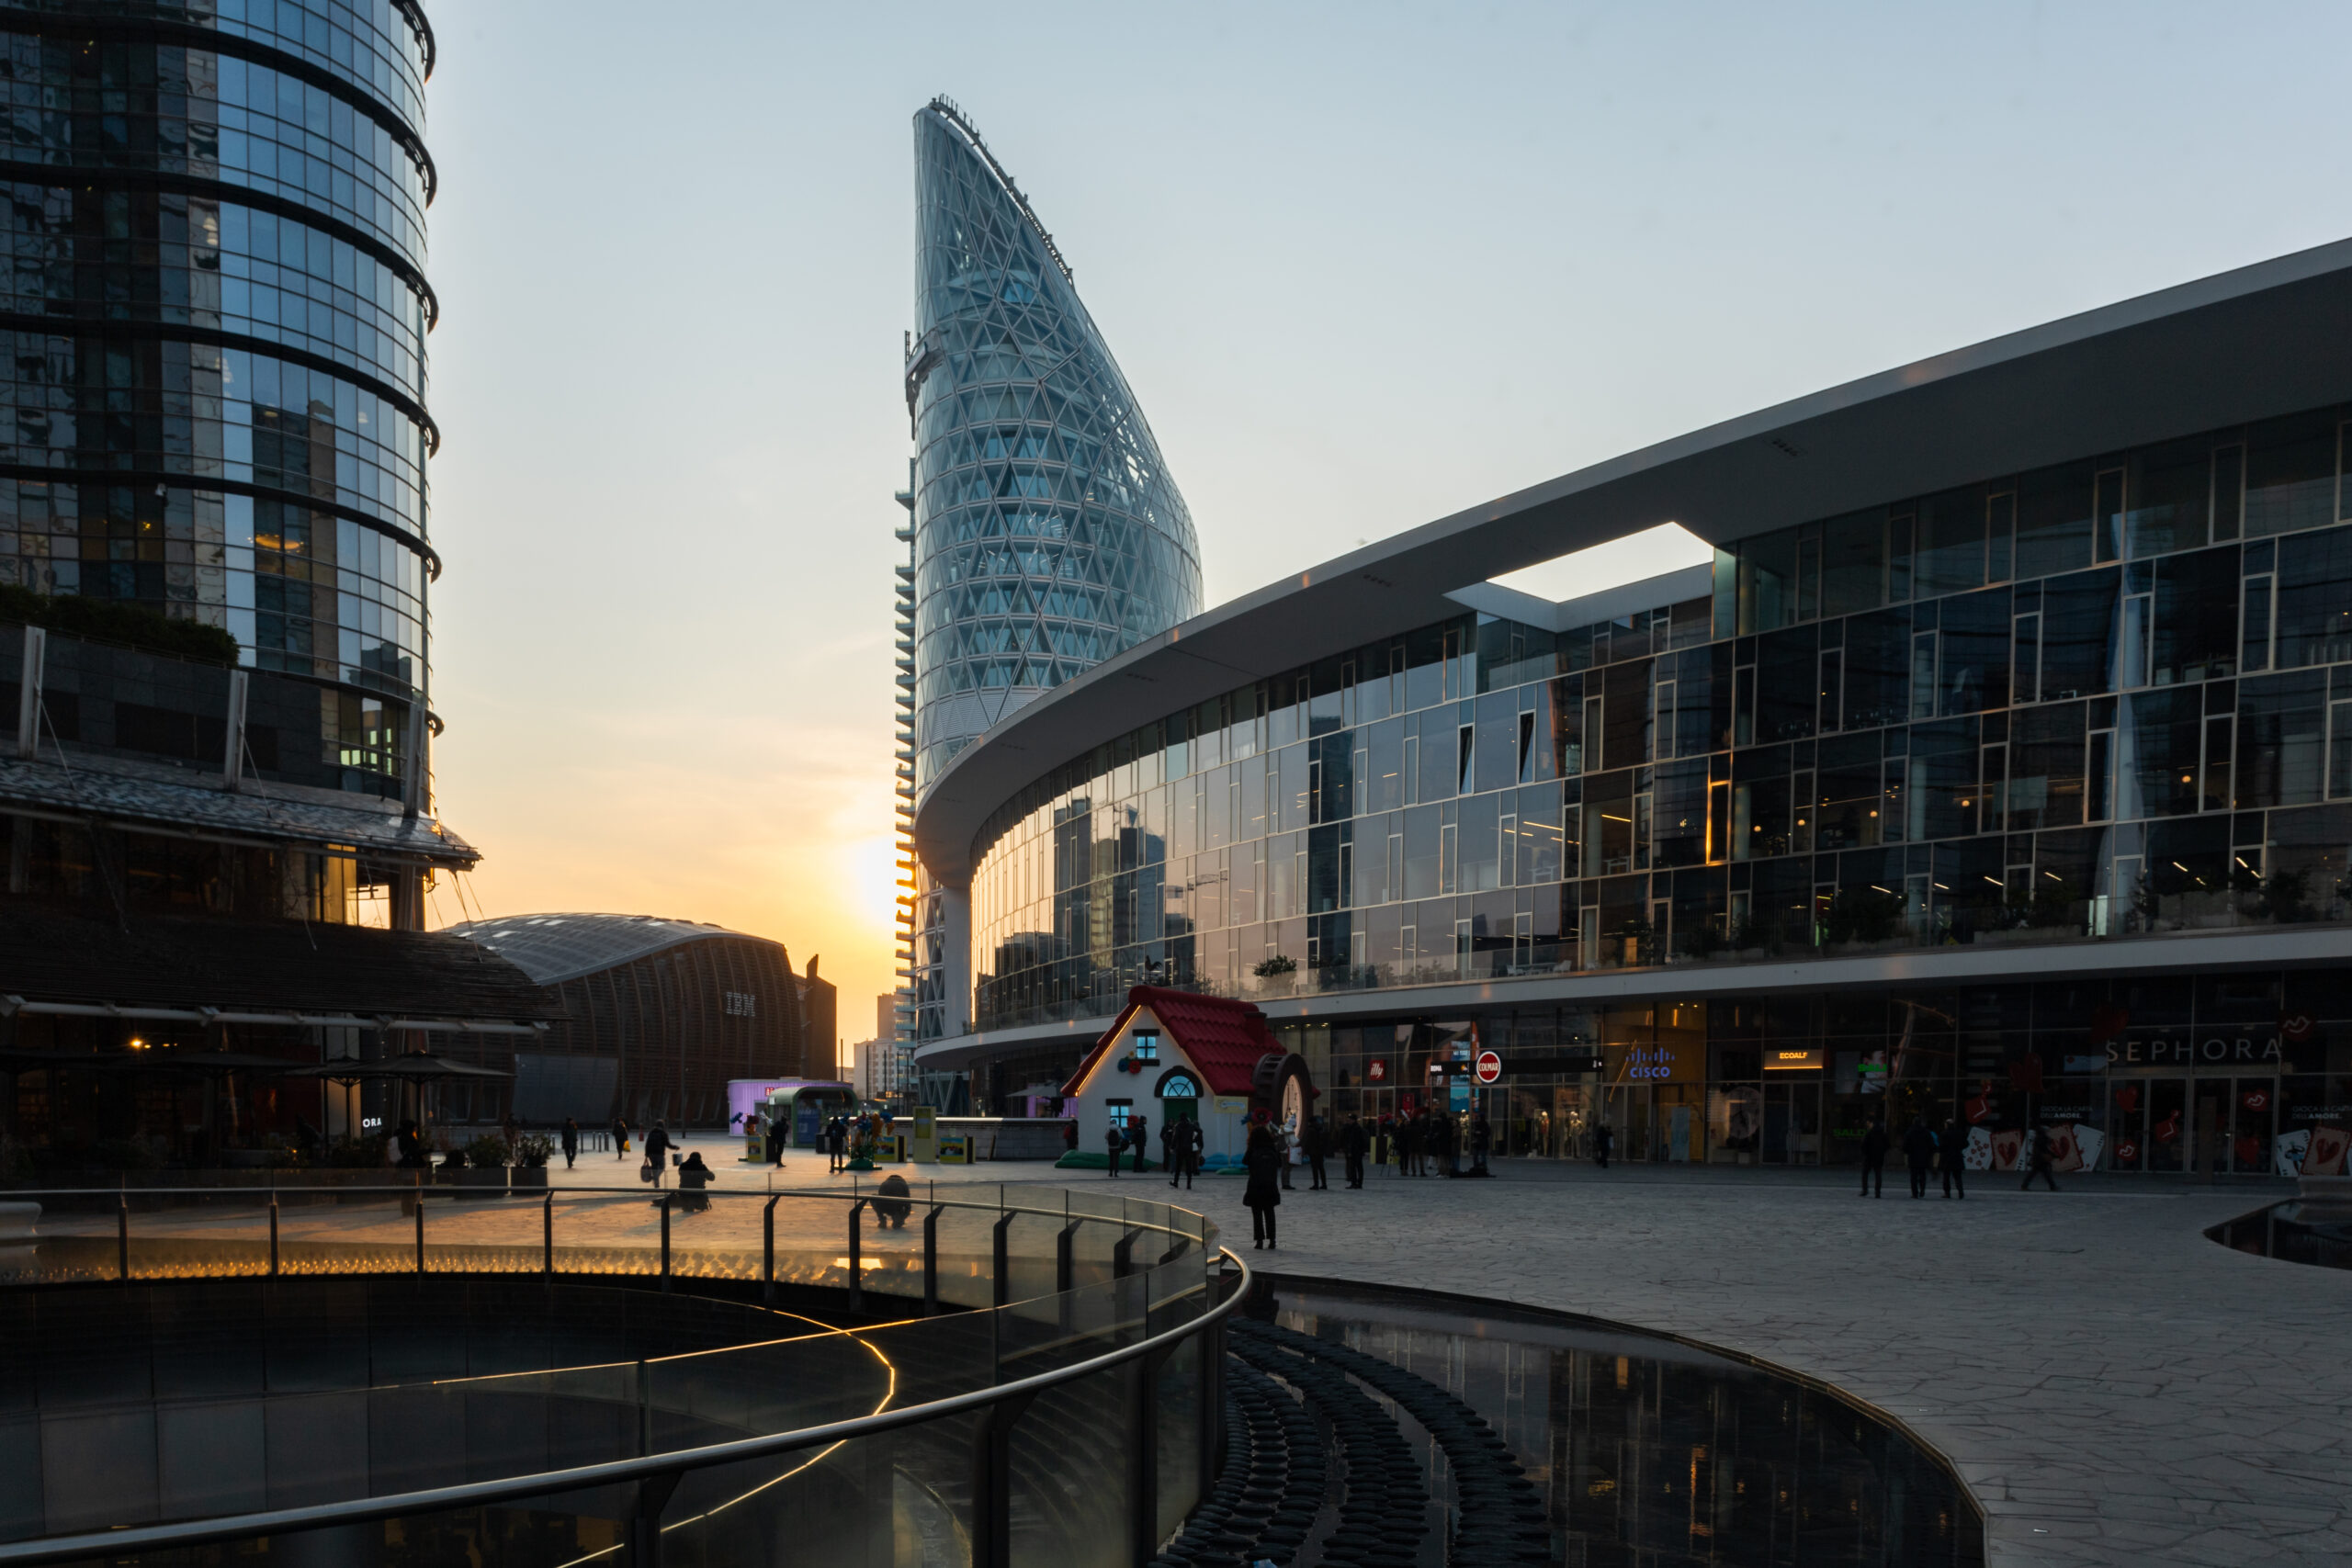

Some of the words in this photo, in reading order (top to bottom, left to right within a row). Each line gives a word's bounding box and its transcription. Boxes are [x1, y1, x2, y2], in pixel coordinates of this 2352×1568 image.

[726, 991, 756, 1017] IBM
[2106, 1038, 2282, 1062] SEPHORA
[1370, 1062, 1384, 1078] illy
[1478, 1062, 1499, 1072] COLMAR
[362, 1117, 382, 1128] ORA
